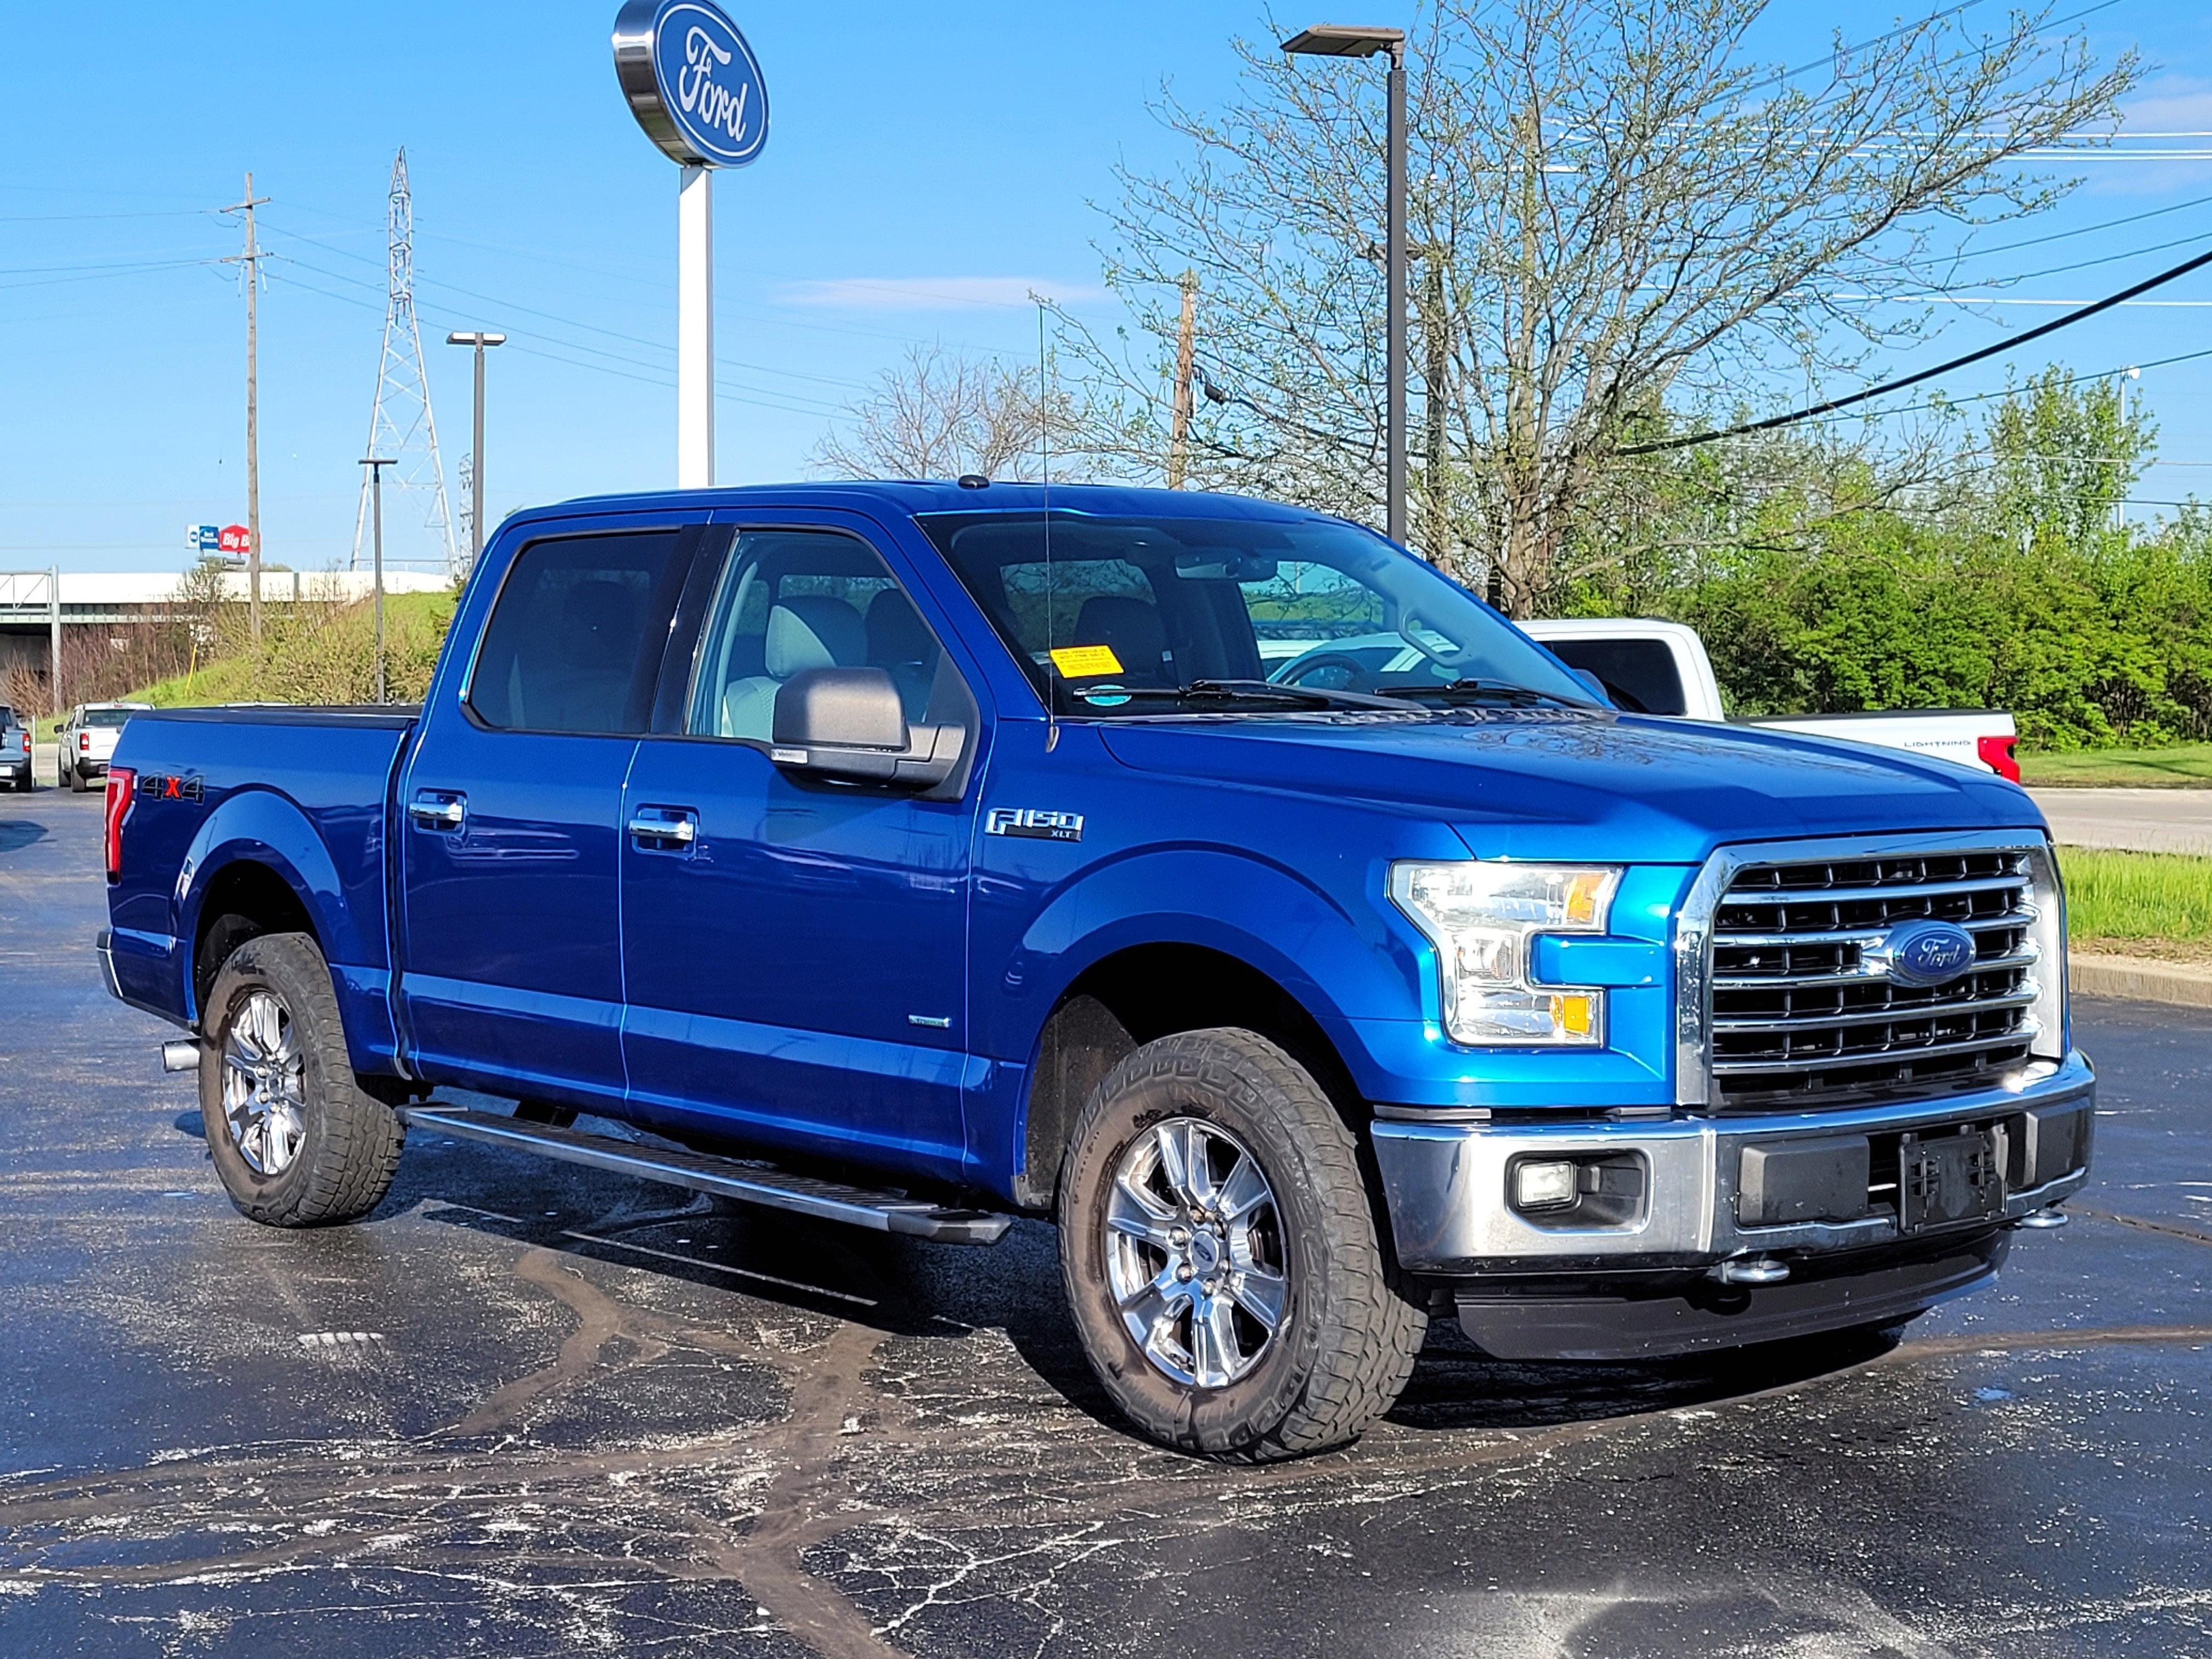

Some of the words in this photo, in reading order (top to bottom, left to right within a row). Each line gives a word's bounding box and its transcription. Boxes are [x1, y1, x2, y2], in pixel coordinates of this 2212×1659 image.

[679, 26, 748, 142] Ford
[222, 532, 240, 549] Big
[1904, 740, 1972, 748] LIGHTNING
[1051, 829, 1071, 838] XLT
[1918, 938, 1961, 968] Ford
